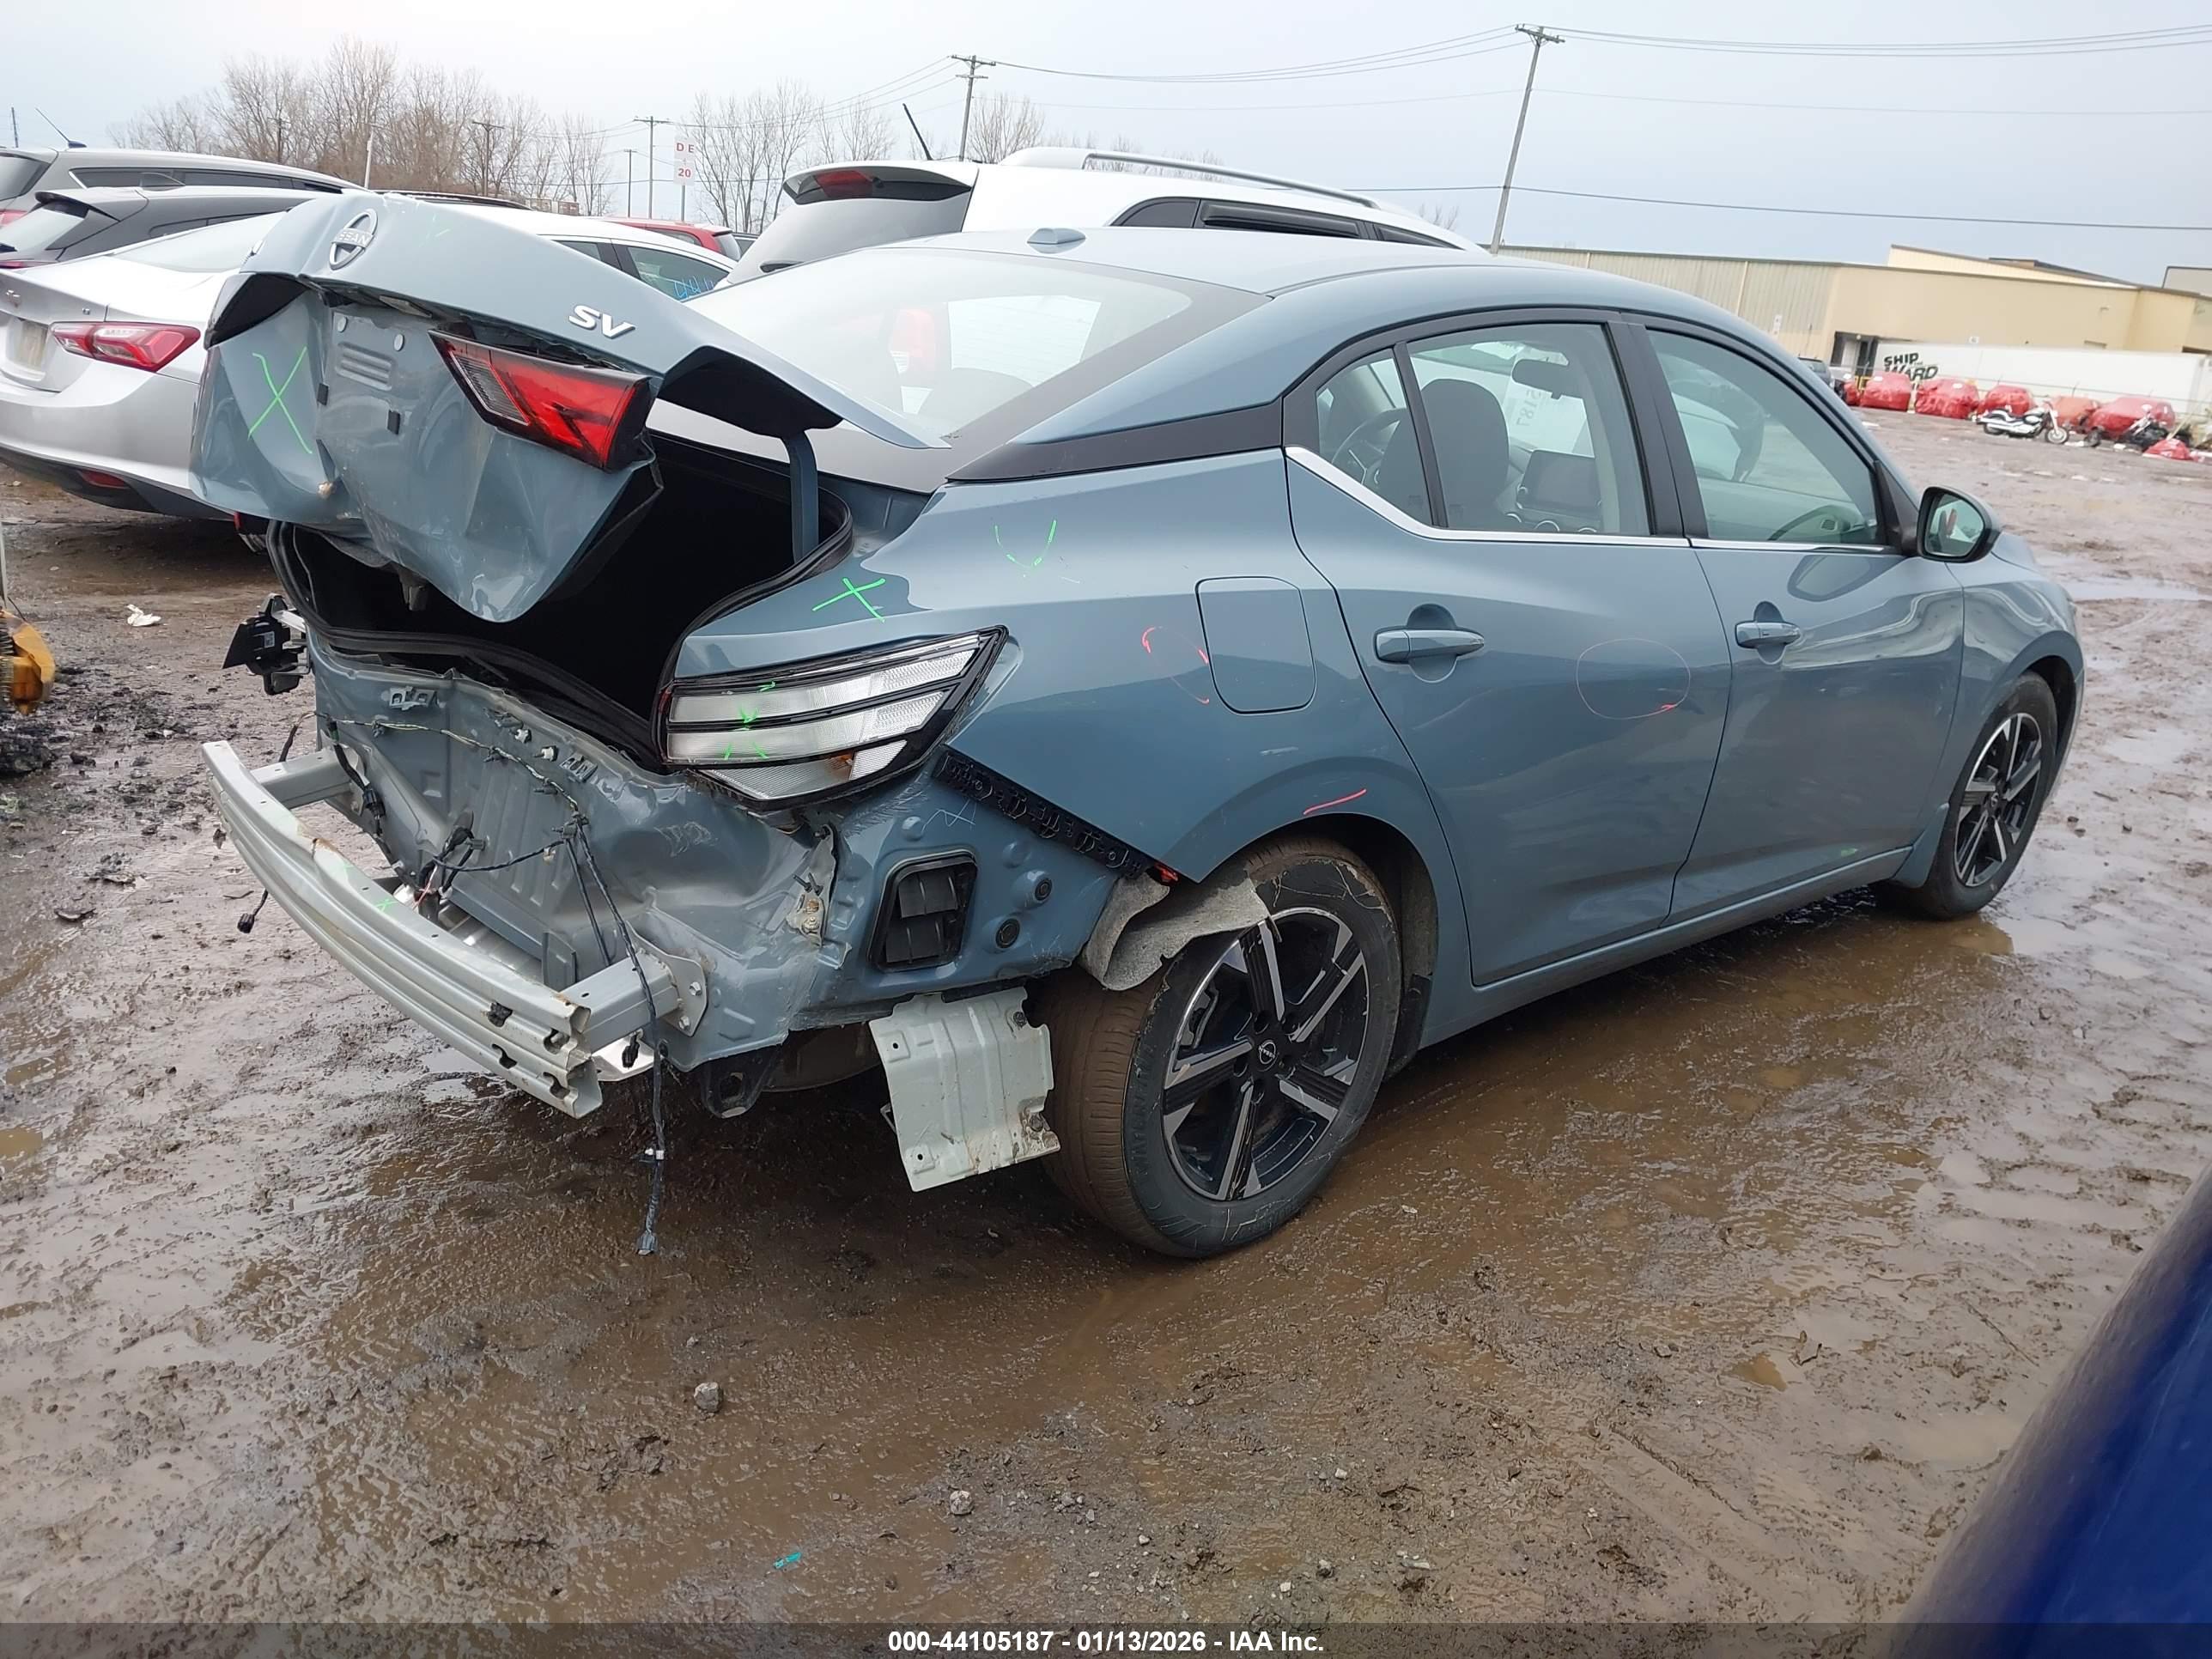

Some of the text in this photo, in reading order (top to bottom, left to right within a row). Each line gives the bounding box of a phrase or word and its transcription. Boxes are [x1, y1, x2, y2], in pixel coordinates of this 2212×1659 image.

[678, 167, 692, 178] 20
[568, 305, 636, 339] SV
[1883, 352, 1920, 368] SHIP
